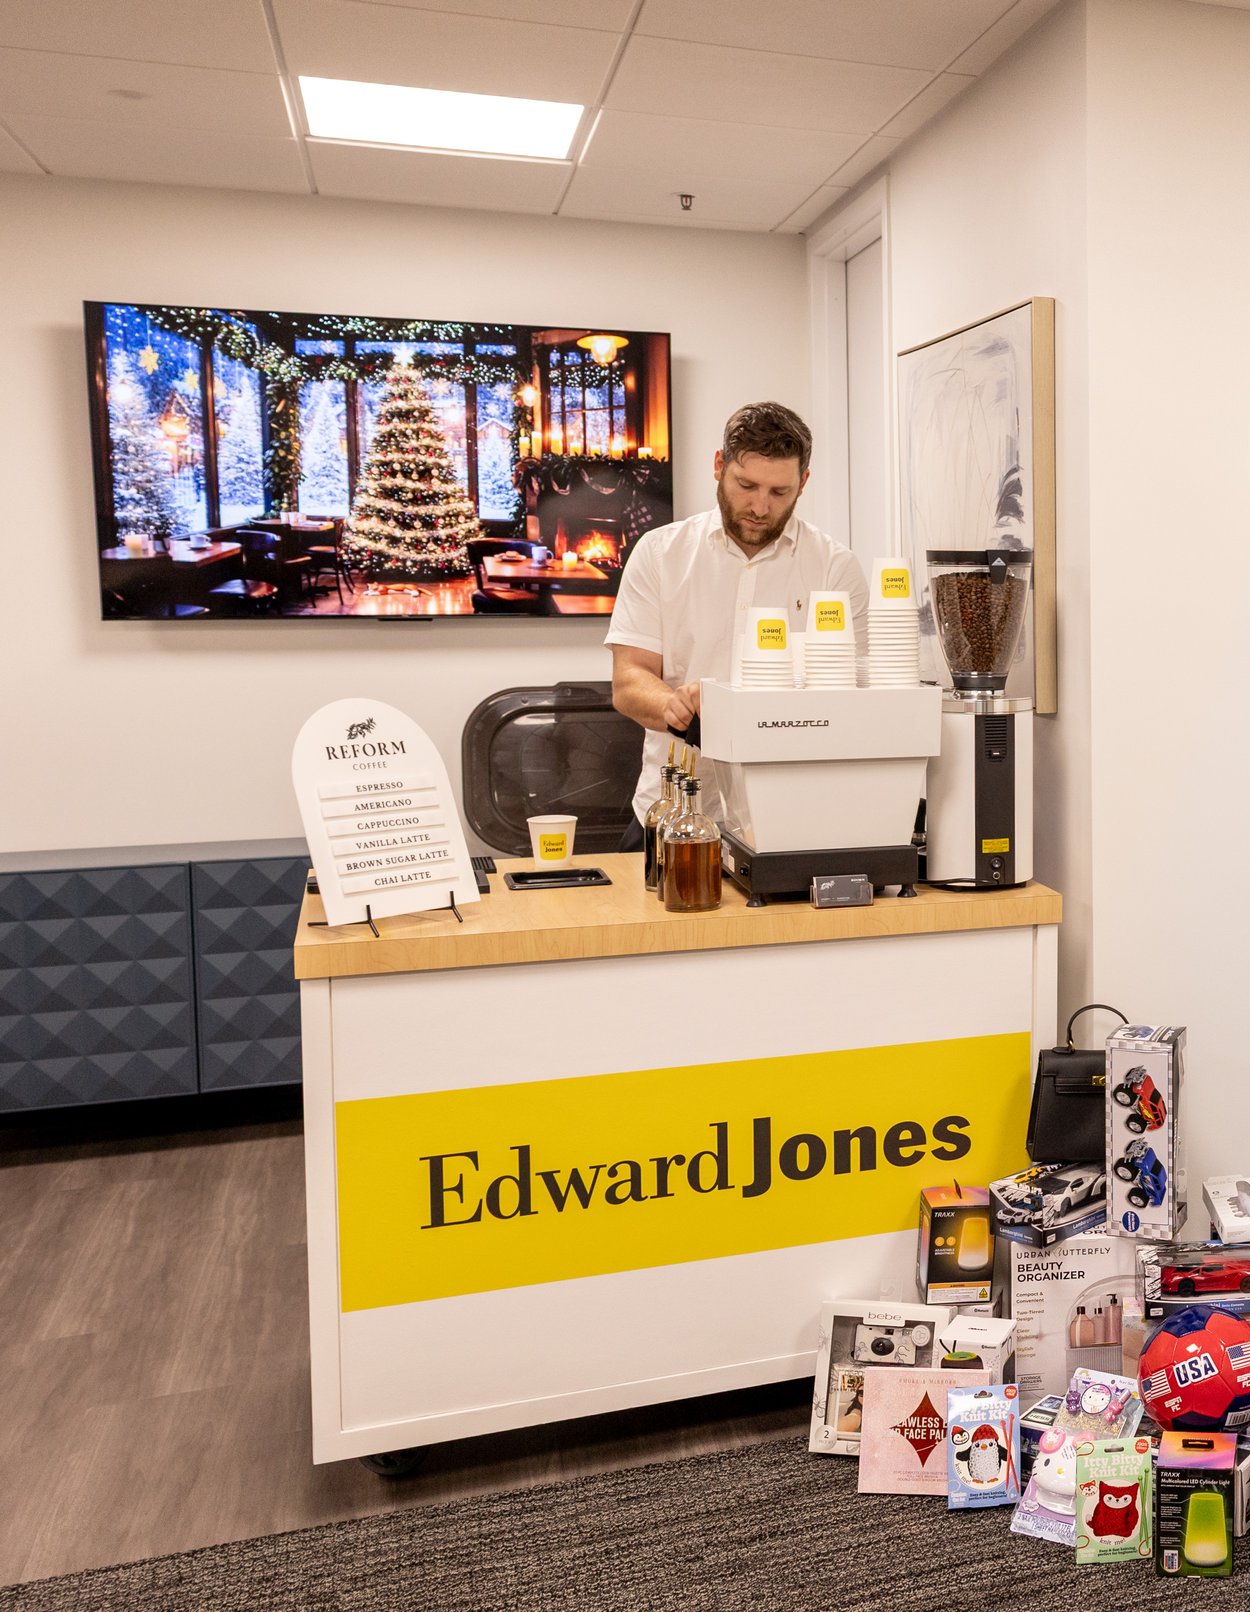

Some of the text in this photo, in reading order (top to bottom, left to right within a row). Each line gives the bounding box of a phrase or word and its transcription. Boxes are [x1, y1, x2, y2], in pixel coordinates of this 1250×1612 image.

[820, 609, 839, 617] Jones
[762, 627, 781, 635] Jones
[326, 741, 407, 760] REFORM
[353, 761, 387, 770] COFFEE
[356, 781, 403, 792] ESPRESSO
[354, 799, 412, 811] AMERICANO
[357, 817, 419, 830] CAPPUCCINO
[356, 834, 430, 849] VANILLA LATTE
[346, 850, 449, 871] BROWN SUGAR LATTE
[374, 871, 431, 886] CHAI LATTE
[419, 1114, 972, 1231] Edward Jones
[1018, 1262, 1063, 1272] BEAUTY
[1017, 1271, 1085, 1282] ORGANIZER
[868, 1312, 902, 1321] bebe
[1174, 1354, 1217, 1386] USA
[1164, 1396, 1182, 1408] ESPN
[1171, 1404, 1181, 1412] FC
[960, 1410, 1008, 1422] Knit Kit
[824, 1430, 830, 1438] 2
[904, 1429, 926, 1440] FACE
[1084, 1455, 1143, 1467] Itty Bitty
[1089, 1466, 1140, 1478] Knit Kit
